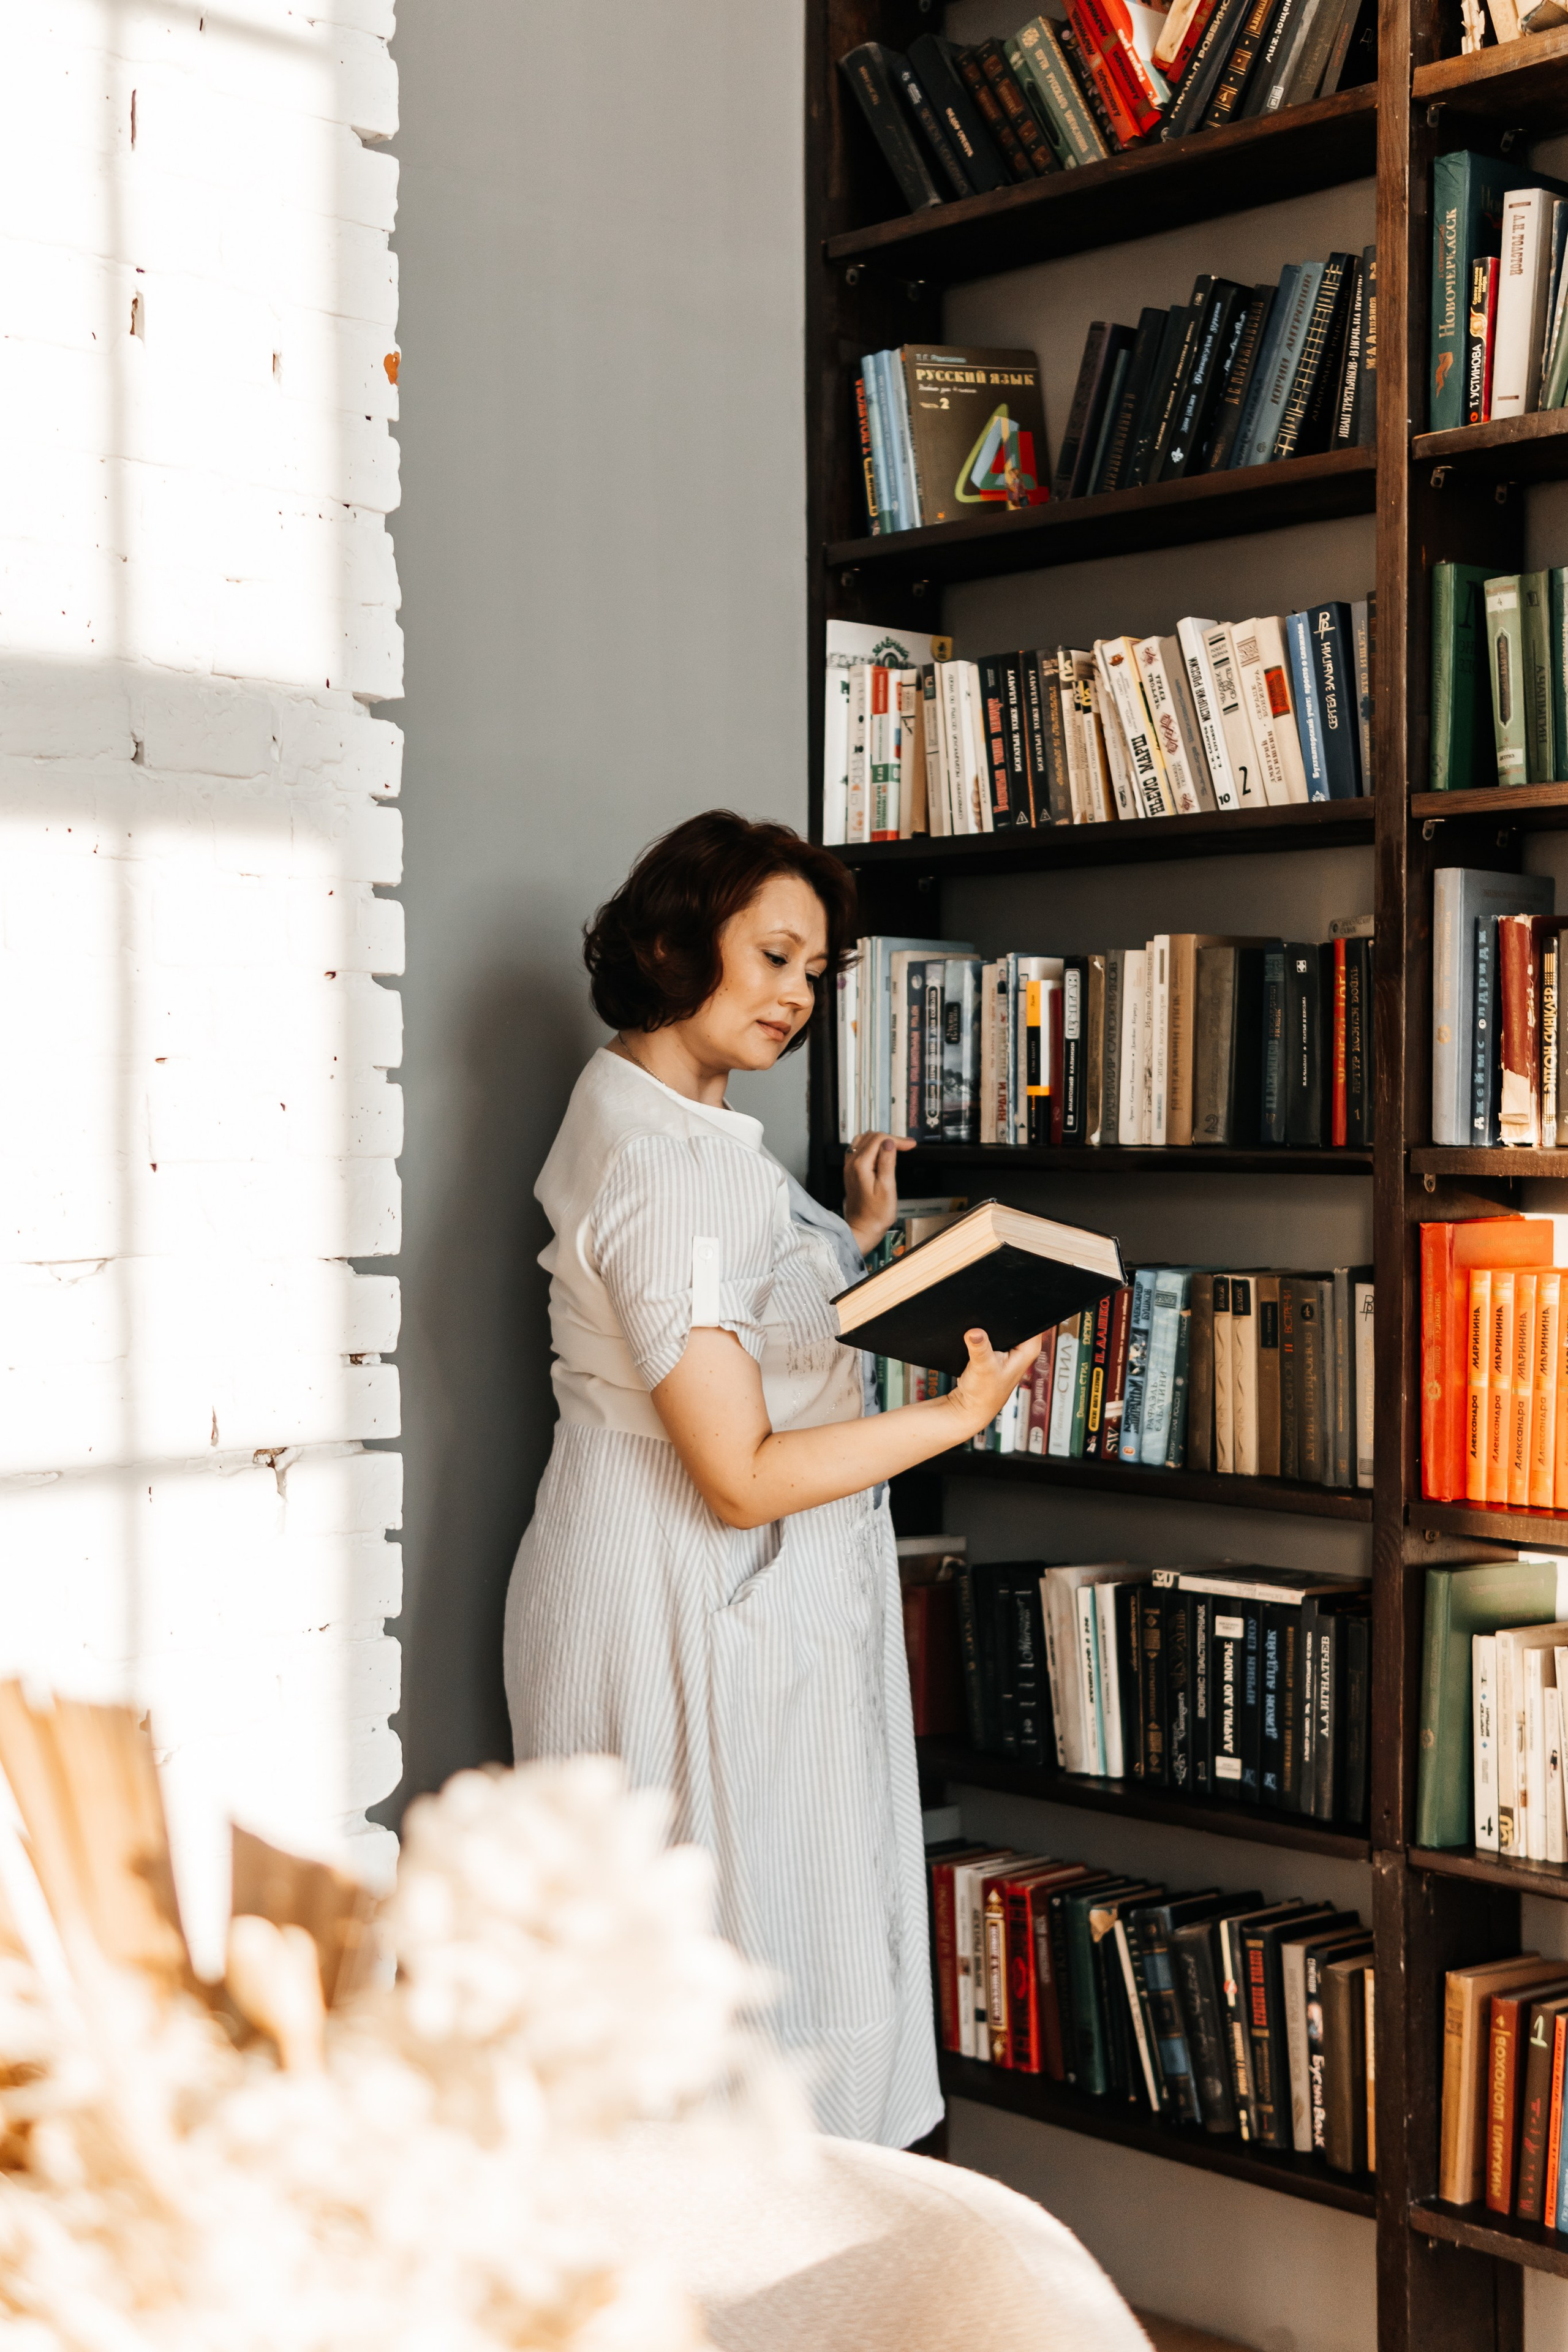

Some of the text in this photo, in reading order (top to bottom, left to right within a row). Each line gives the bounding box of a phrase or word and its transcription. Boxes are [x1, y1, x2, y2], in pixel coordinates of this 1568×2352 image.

[1349, 325, 1362, 350] НОЧЬ
[914, 365, 1034, 386] РУССКИЙ ЯЗЫК
[1341, 361, 1358, 413] ТРЕТЬЯКОВ
[1468, 343, 1483, 408] Т. УСТИНОВА
[938, 397, 950, 409] 2
[1338, 413, 1351, 438] ИВАН
[1147, 672, 1160, 710] ЧЕРТОВА
[1154, 673, 1166, 701] КУКЛА
[1187, 656, 1203, 687] РОССИИ
[1213, 671, 1228, 704] ЧЕЛОВЕК
[1224, 666, 1238, 699] СВОЙСТВ
[1319, 641, 1339, 729] СЕРГЕЙ ЗАЛЫГИН
[1006, 669, 1022, 772] БОГАТЫЕ ТОЖЕ ПЛАЧУТ
[1028, 669, 1044, 771] БОГАТЫЕ ТОЖЕ ПЛАЧУТ
[1194, 688, 1212, 723] ИСТОРИЯ
[1130, 733, 1154, 774] МАРШ
[1261, 739, 1276, 783] ДМИТРИЙ
[1267, 730, 1282, 781] НАГИШКИН
[1218, 793, 1231, 805] 10
[1239, 766, 1251, 796] 2
[1068, 973, 1078, 1035] ЦЫГАН
[1349, 965, 1360, 1003] ДОЙЛЬ
[1106, 960, 1118, 1131] ВЛАДИМИР САПОЖНИКОВ
[1544, 987, 1556, 1093] ЭПТОН СИНКЛЕР
[1351, 1055, 1361, 1093] АРТУР
[998, 1082, 1006, 1120] ВРАГИ
[1354, 1109, 1359, 1120] 1
[1204, 1114, 1218, 1133] 2
[1133, 1281, 1143, 1324] АЛЕКСАНДР
[1140, 1287, 1154, 1321] БУШКОВ
[1216, 1284, 1226, 1308] БЛОК
[1235, 1286, 1245, 1311] БЛОК
[1283, 1289, 1292, 1333] ВСТРЕЧИ
[1095, 1295, 1110, 1349] ДАШКО
[1055, 1344, 1073, 1393] СТИЛ
[1537, 1306, 1550, 1465] Александра МАРИНИНА
[1147, 1381, 1158, 1430] РАФАЭЛЬ
[1154, 1371, 1167, 1431] САБАТИНИ
[1171, 1390, 1182, 1417] РОССИЯ
[1514, 1311, 1528, 1470] Александра МАРИНИНА
[1104, 1426, 1121, 1453] SW
[1470, 1395, 1479, 1458] Александра
[1492, 1395, 1501, 1463] Александра
[1197, 1604, 1205, 1717] БОРИС ПАСТЕРНАК
[1245, 1617, 1257, 1705] ИРВИН ШОУ
[1223, 1642, 1234, 1752] ДАФНА ДЮ МОРЬЕ
[1265, 1630, 1279, 1738] ДЖОН АПДАЙК
[1196, 1761, 1205, 1780] 1
[1530, 2015, 1548, 2048] 1
[1489, 2035, 1507, 2196] МИХАИЛ ШОЛОХОВ
